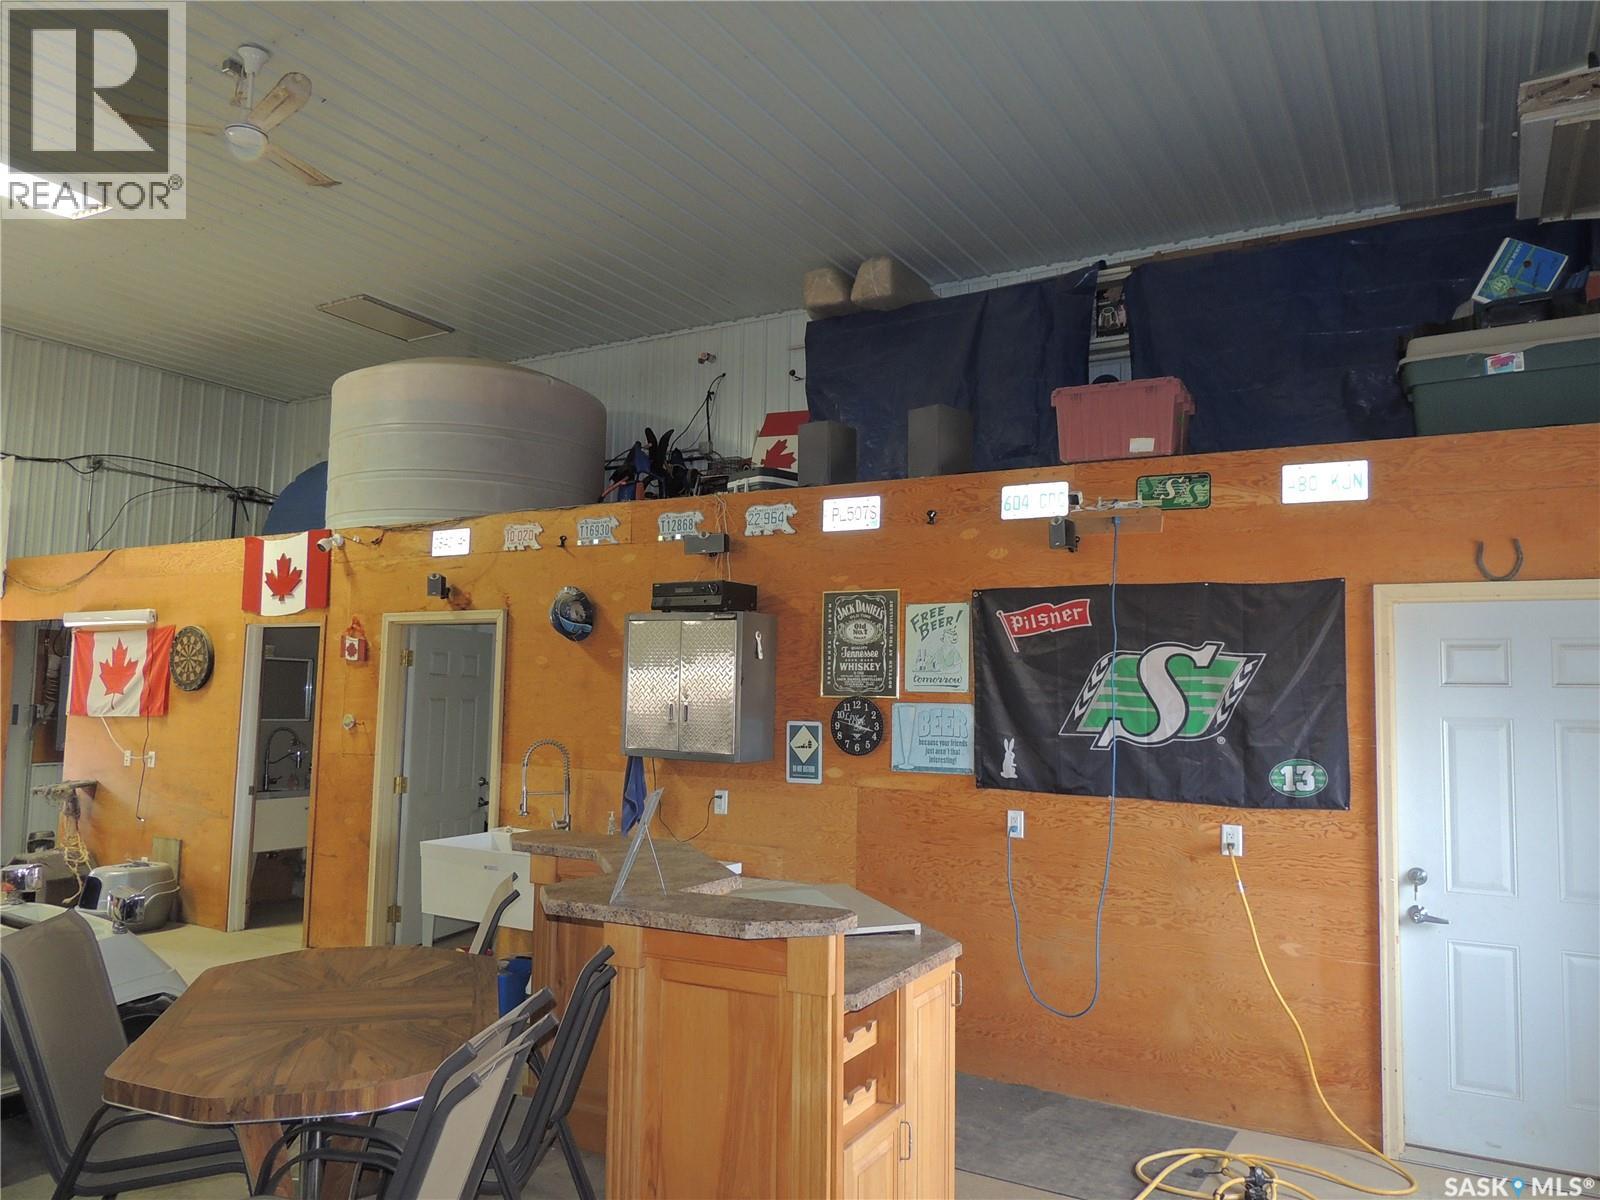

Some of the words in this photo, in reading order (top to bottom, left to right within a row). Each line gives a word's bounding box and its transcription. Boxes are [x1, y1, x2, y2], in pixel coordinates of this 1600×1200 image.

[837, 603, 855, 621] JACK
[911, 606, 946, 632] FREE
[1010, 608, 1083, 632] Pilsner
[841, 646, 879, 658] Tennessee
[840, 662, 881, 671] WHISKEY
[913, 674, 963, 683] tomorrow
[844, 703, 850, 711] 11
[865, 703, 868, 711] 1
[837, 711, 845, 719] 10
[871, 711, 877, 719] 2
[835, 722, 840, 730] 9
[874, 722, 879, 731] 3
[918, 708, 968, 739] BEER
[837, 731, 842, 740] 8
[872, 732, 877, 741] 4
[845, 740, 850, 748] 7
[855, 743, 860, 751] 6
[866, 740, 871, 748] 5
[1280, 765, 1315, 791] 13
